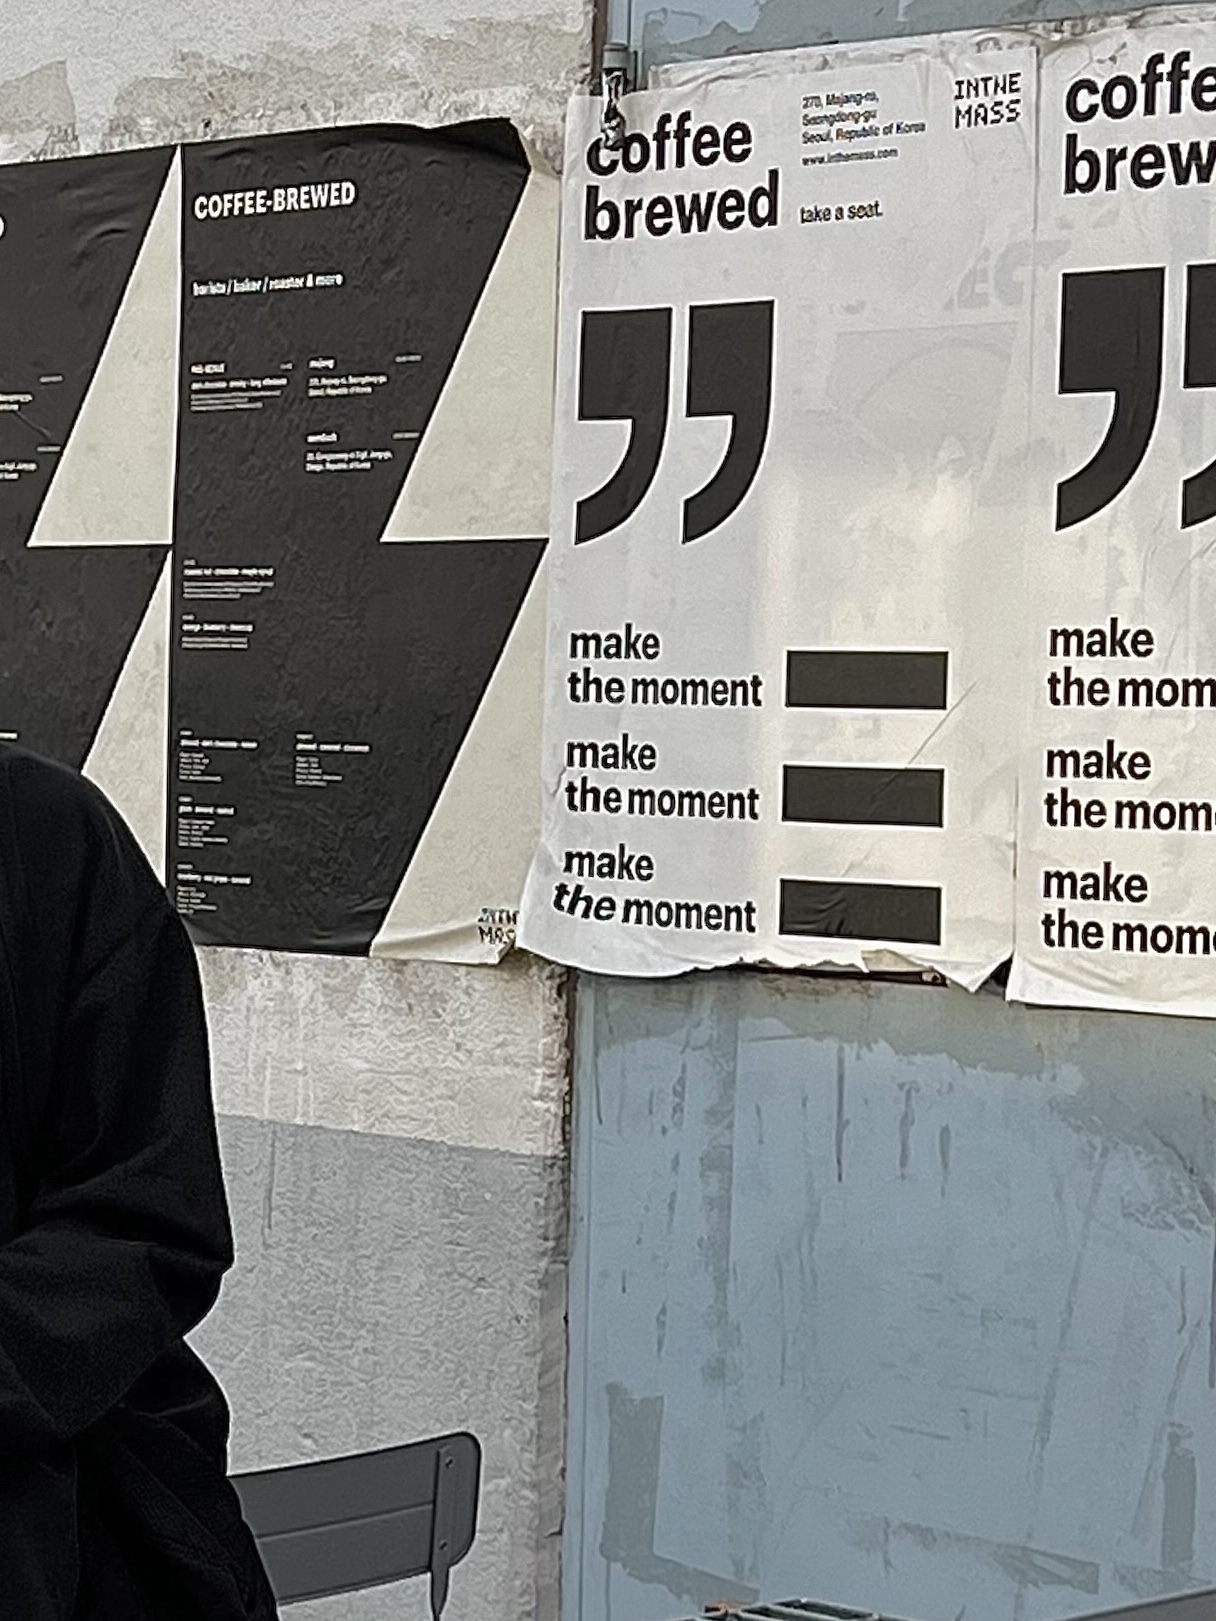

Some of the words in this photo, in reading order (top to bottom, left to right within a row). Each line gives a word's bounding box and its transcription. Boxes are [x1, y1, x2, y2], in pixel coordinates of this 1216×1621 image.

[835, 125, 881, 142] Republic
[882, 122, 894, 135] of
[895, 121, 926, 135] Korea
[954, 99, 1022, 129] MASS
[586, 109, 753, 177] coffee
[584, 167, 780, 241] brewed
[799, 205, 832, 224] take
[834, 206, 845, 220] a
[847, 200, 884, 219] seat.
[569, 622, 661, 660] make
[1048, 616, 1155, 658] make
[567, 666, 625, 704] the
[631, 674, 763, 707] moment
[1047, 665, 1111, 707] the
[566, 733, 657, 771] make
[1046, 738, 1152, 781] make
[565, 776, 622, 813] the
[628, 787, 759, 820] moment
[1043, 786, 1107, 828] the
[1114, 799, 1216, 832] mom
[563, 843, 654, 882] make
[1042, 860, 1149, 903] make
[553, 882, 617, 921] the
[621, 898, 757, 934] moment
[1041, 907, 1105, 950] the
[1112, 922, 1216, 955] mom
